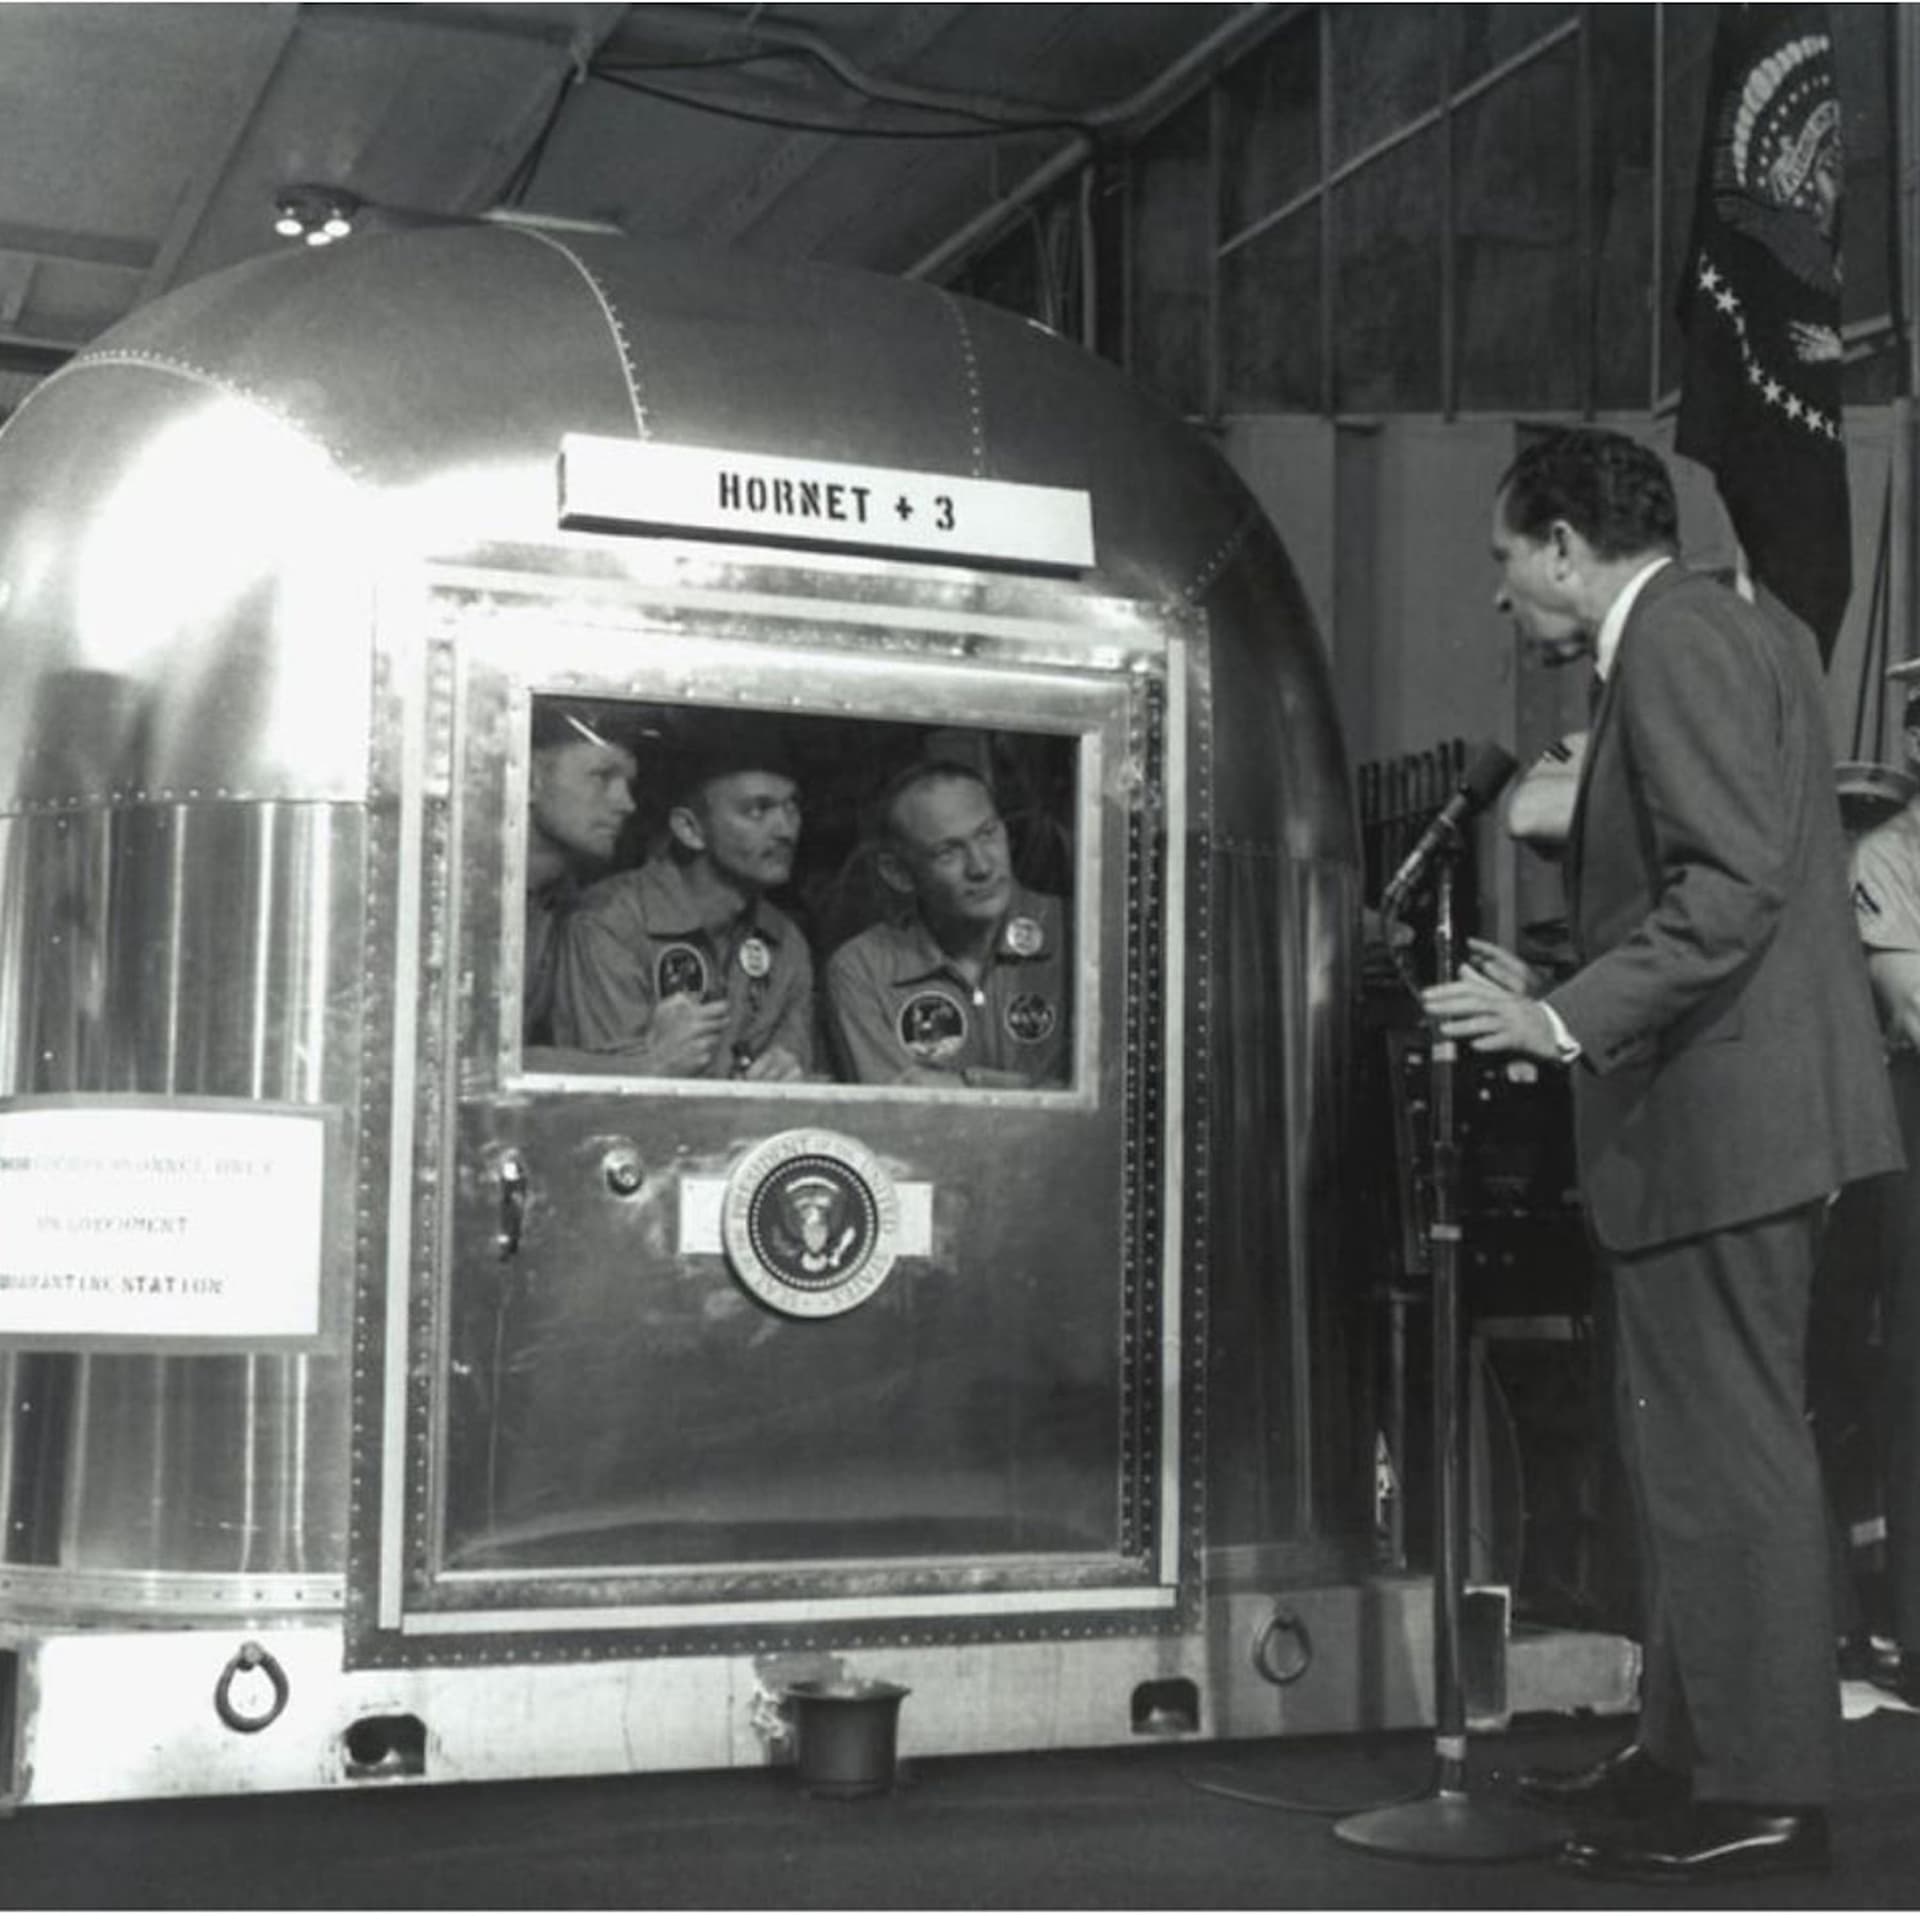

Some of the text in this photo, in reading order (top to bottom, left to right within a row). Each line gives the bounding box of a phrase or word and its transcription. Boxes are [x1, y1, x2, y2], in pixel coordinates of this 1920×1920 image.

[719, 471, 871, 523] HORNET
[934, 495, 956, 531] 3
[121, 1276, 223, 1295] STATION
